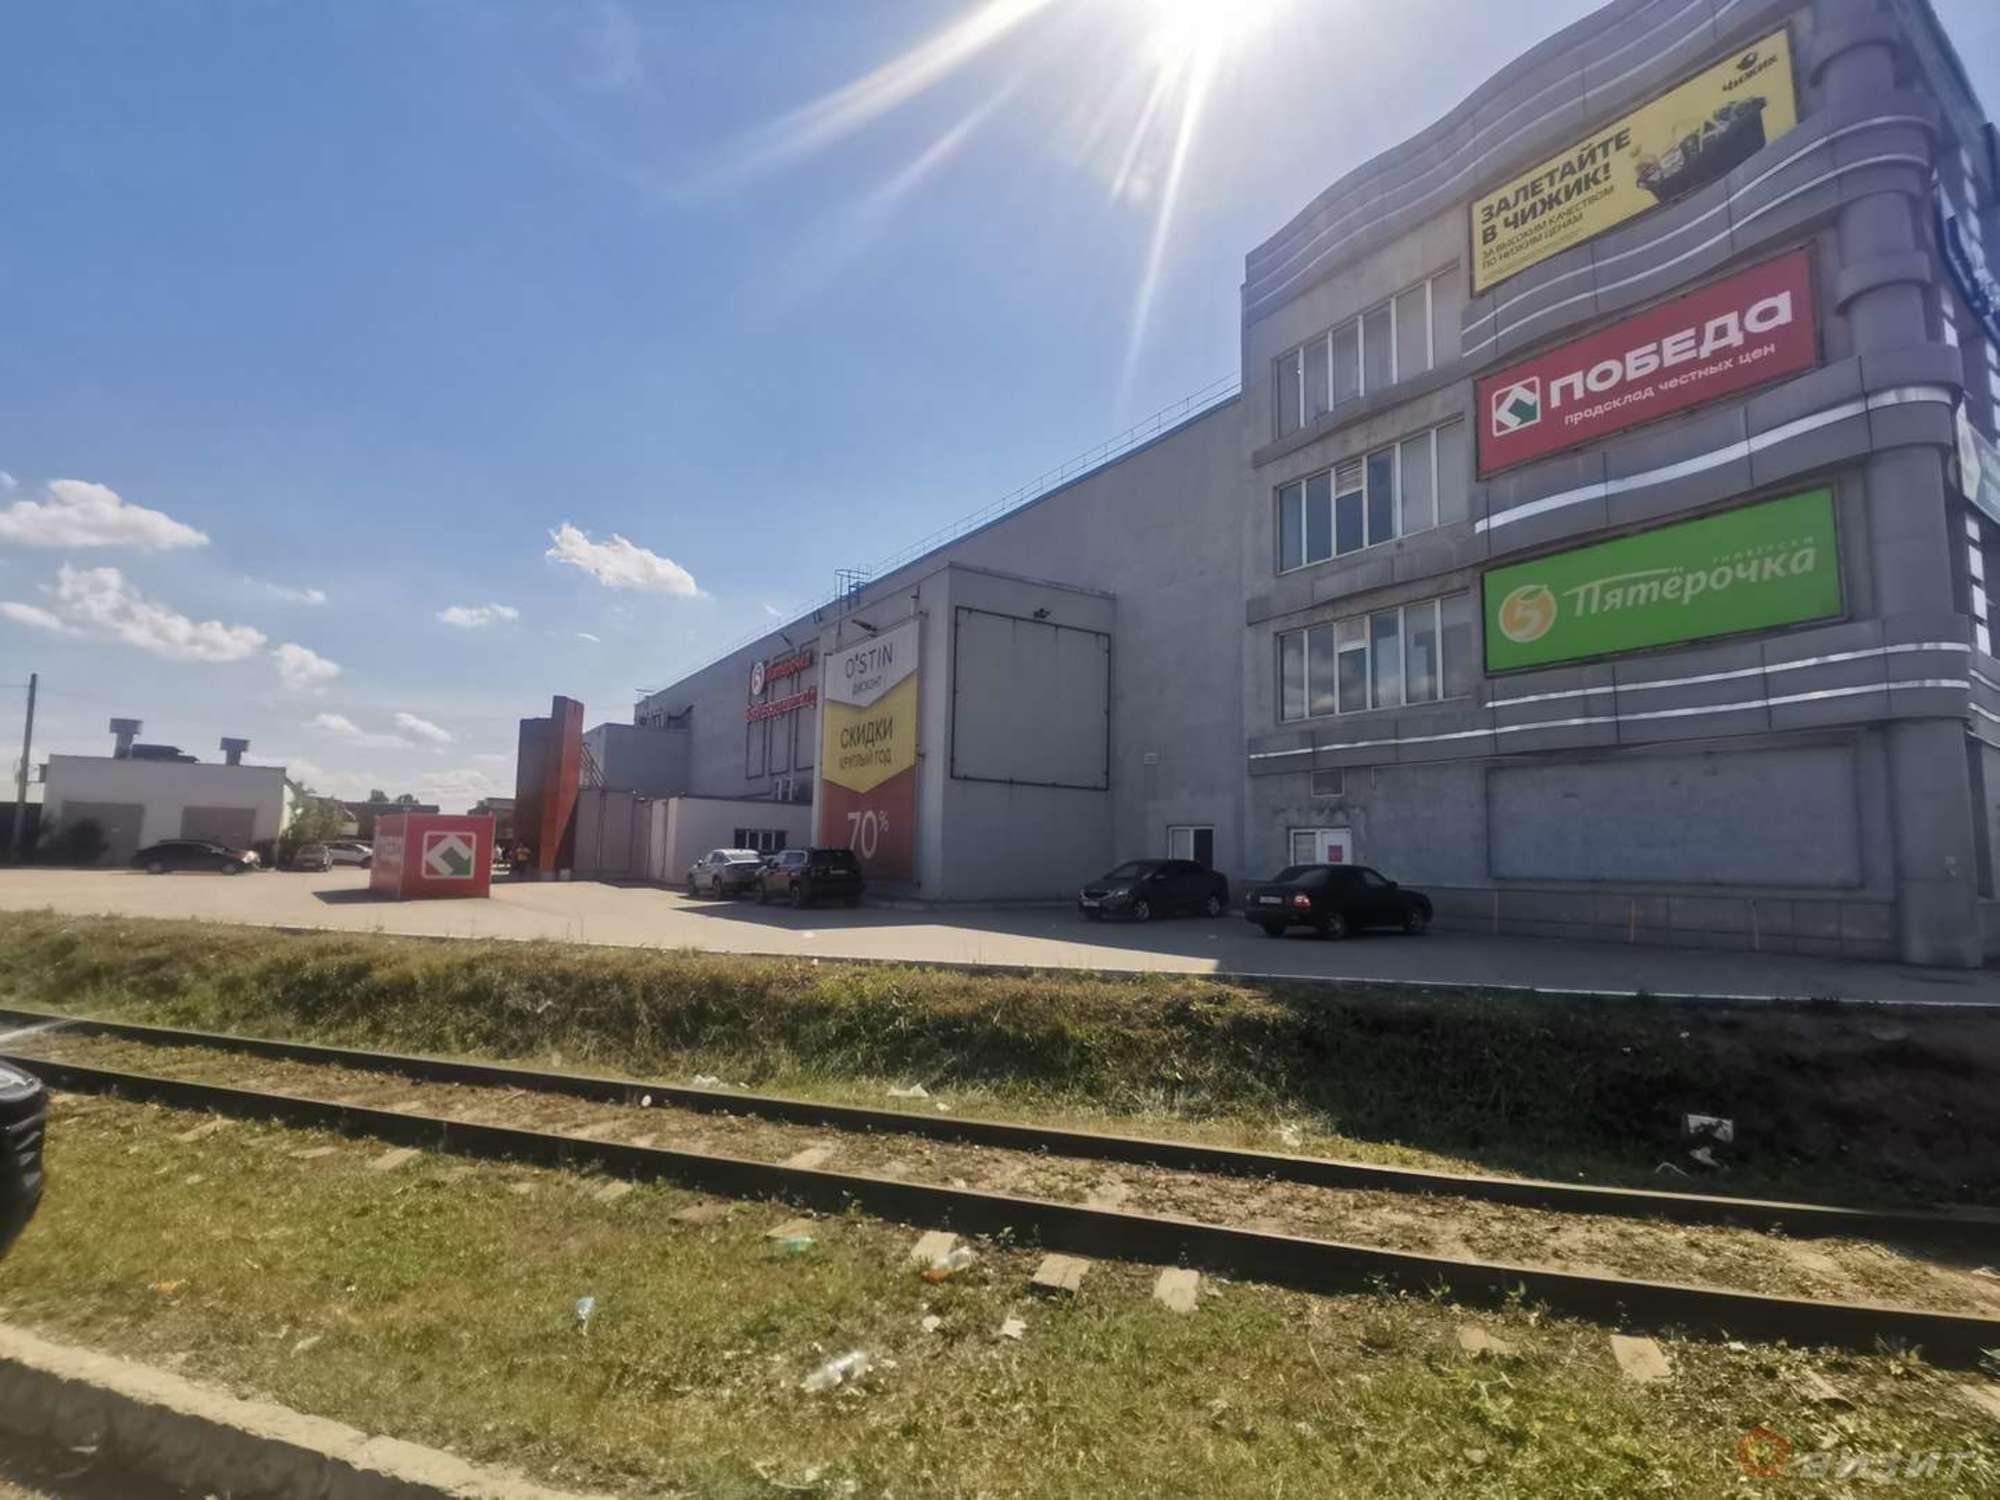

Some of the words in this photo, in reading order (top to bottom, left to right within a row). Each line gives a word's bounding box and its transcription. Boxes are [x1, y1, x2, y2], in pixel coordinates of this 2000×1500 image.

[1480, 127, 1631, 225] ЗАЛЕТАЙТЕ
[1482, 224, 1497, 246] В
[1503, 161, 1611, 230] ЧИЖИК!
[1563, 385, 1656, 427] продсклад
[1658, 358, 1734, 393] честных
[1738, 342, 1776, 366] цен
[845, 641, 894, 680] O'STIN
[839, 716, 894, 750] СКИДКИ
